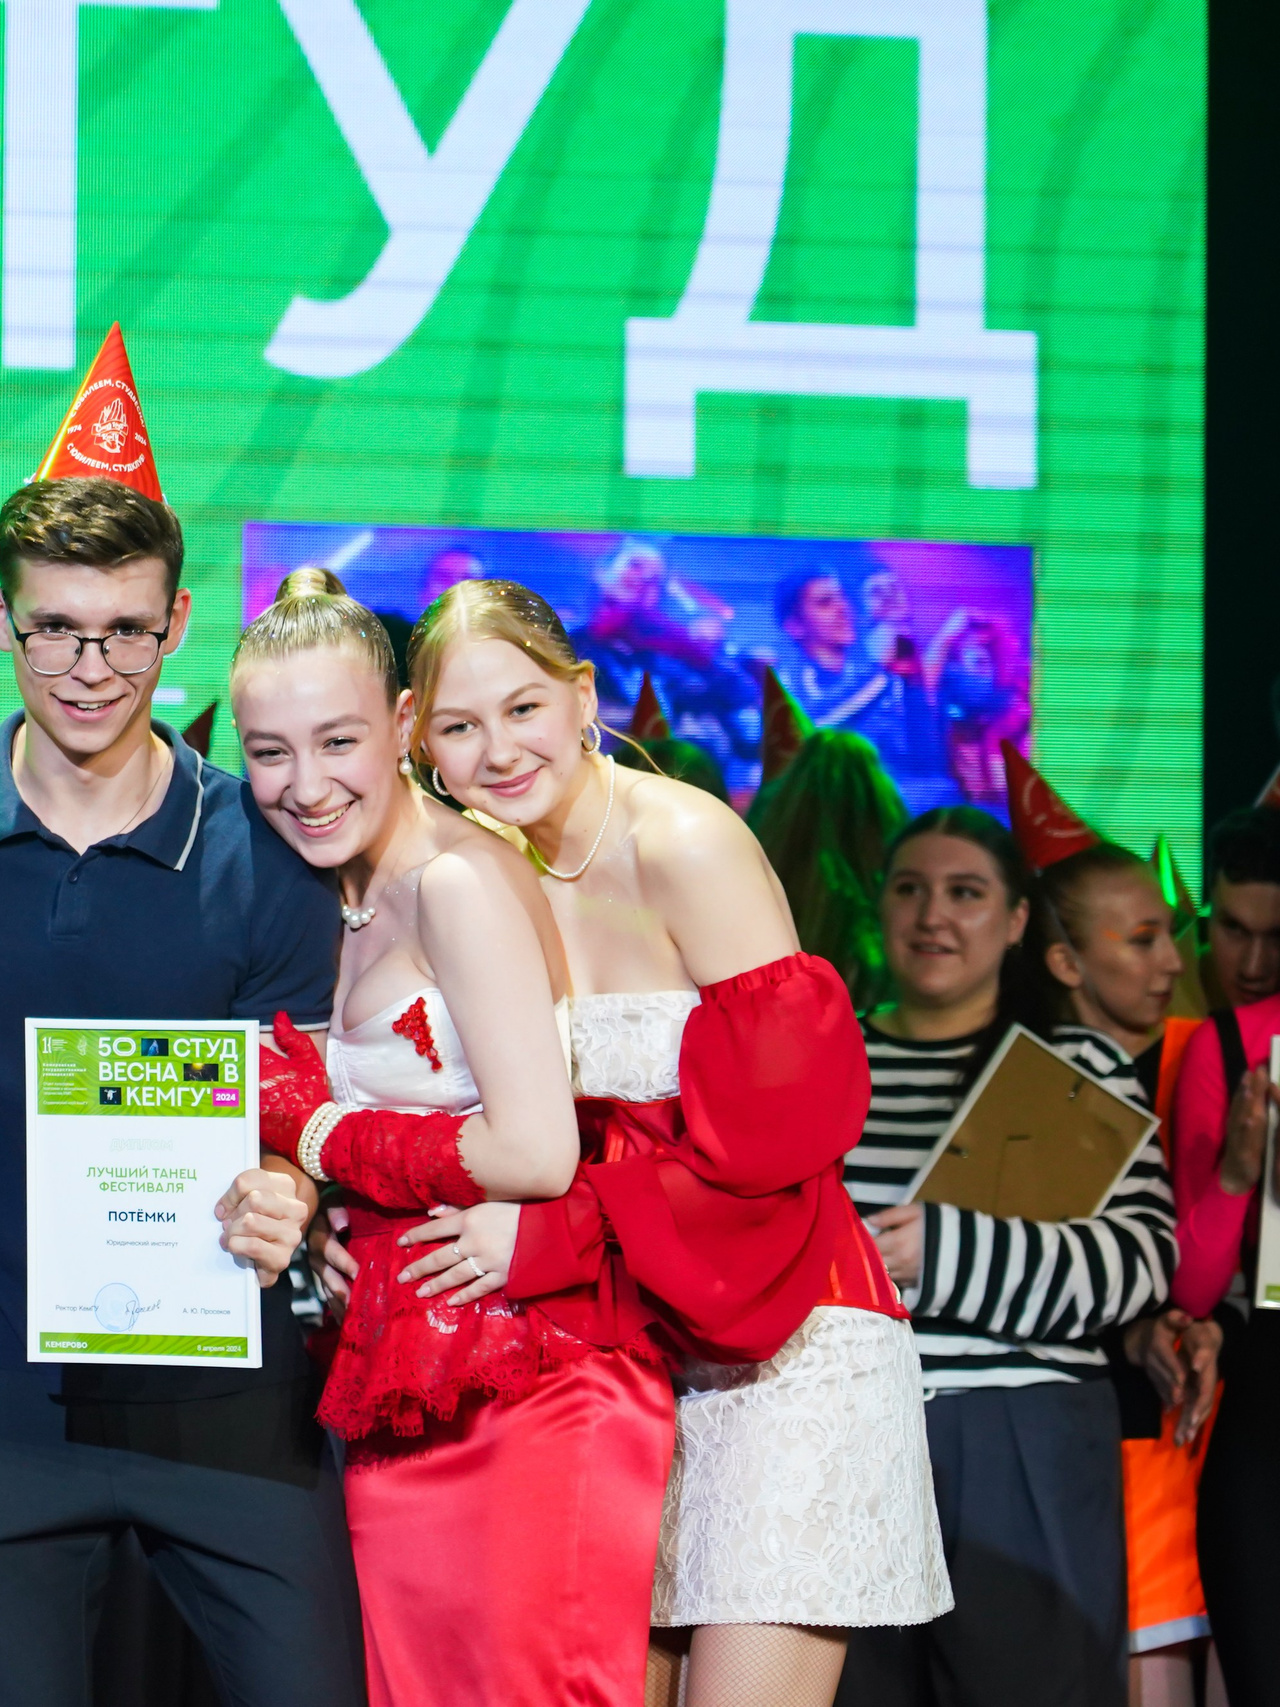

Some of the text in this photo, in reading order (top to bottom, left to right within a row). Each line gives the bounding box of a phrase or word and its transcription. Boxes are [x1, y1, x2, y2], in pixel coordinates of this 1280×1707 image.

[98, 1037, 238, 1061] 50 СТУД
[98, 1062, 239, 1083] ВЕСНА В
[215, 1093, 236, 1102] 2024
[86, 1165, 198, 1181] ЛУЧШИЙ ТАНЕЦ
[98, 1181, 185, 1194] ФЕСТИВАЛЯ
[108, 1209, 177, 1224] ПОТЁМКИ
[106, 1239, 179, 1248] Юридический институт
[45, 1341, 88, 1349] КЕМЕРОВО
